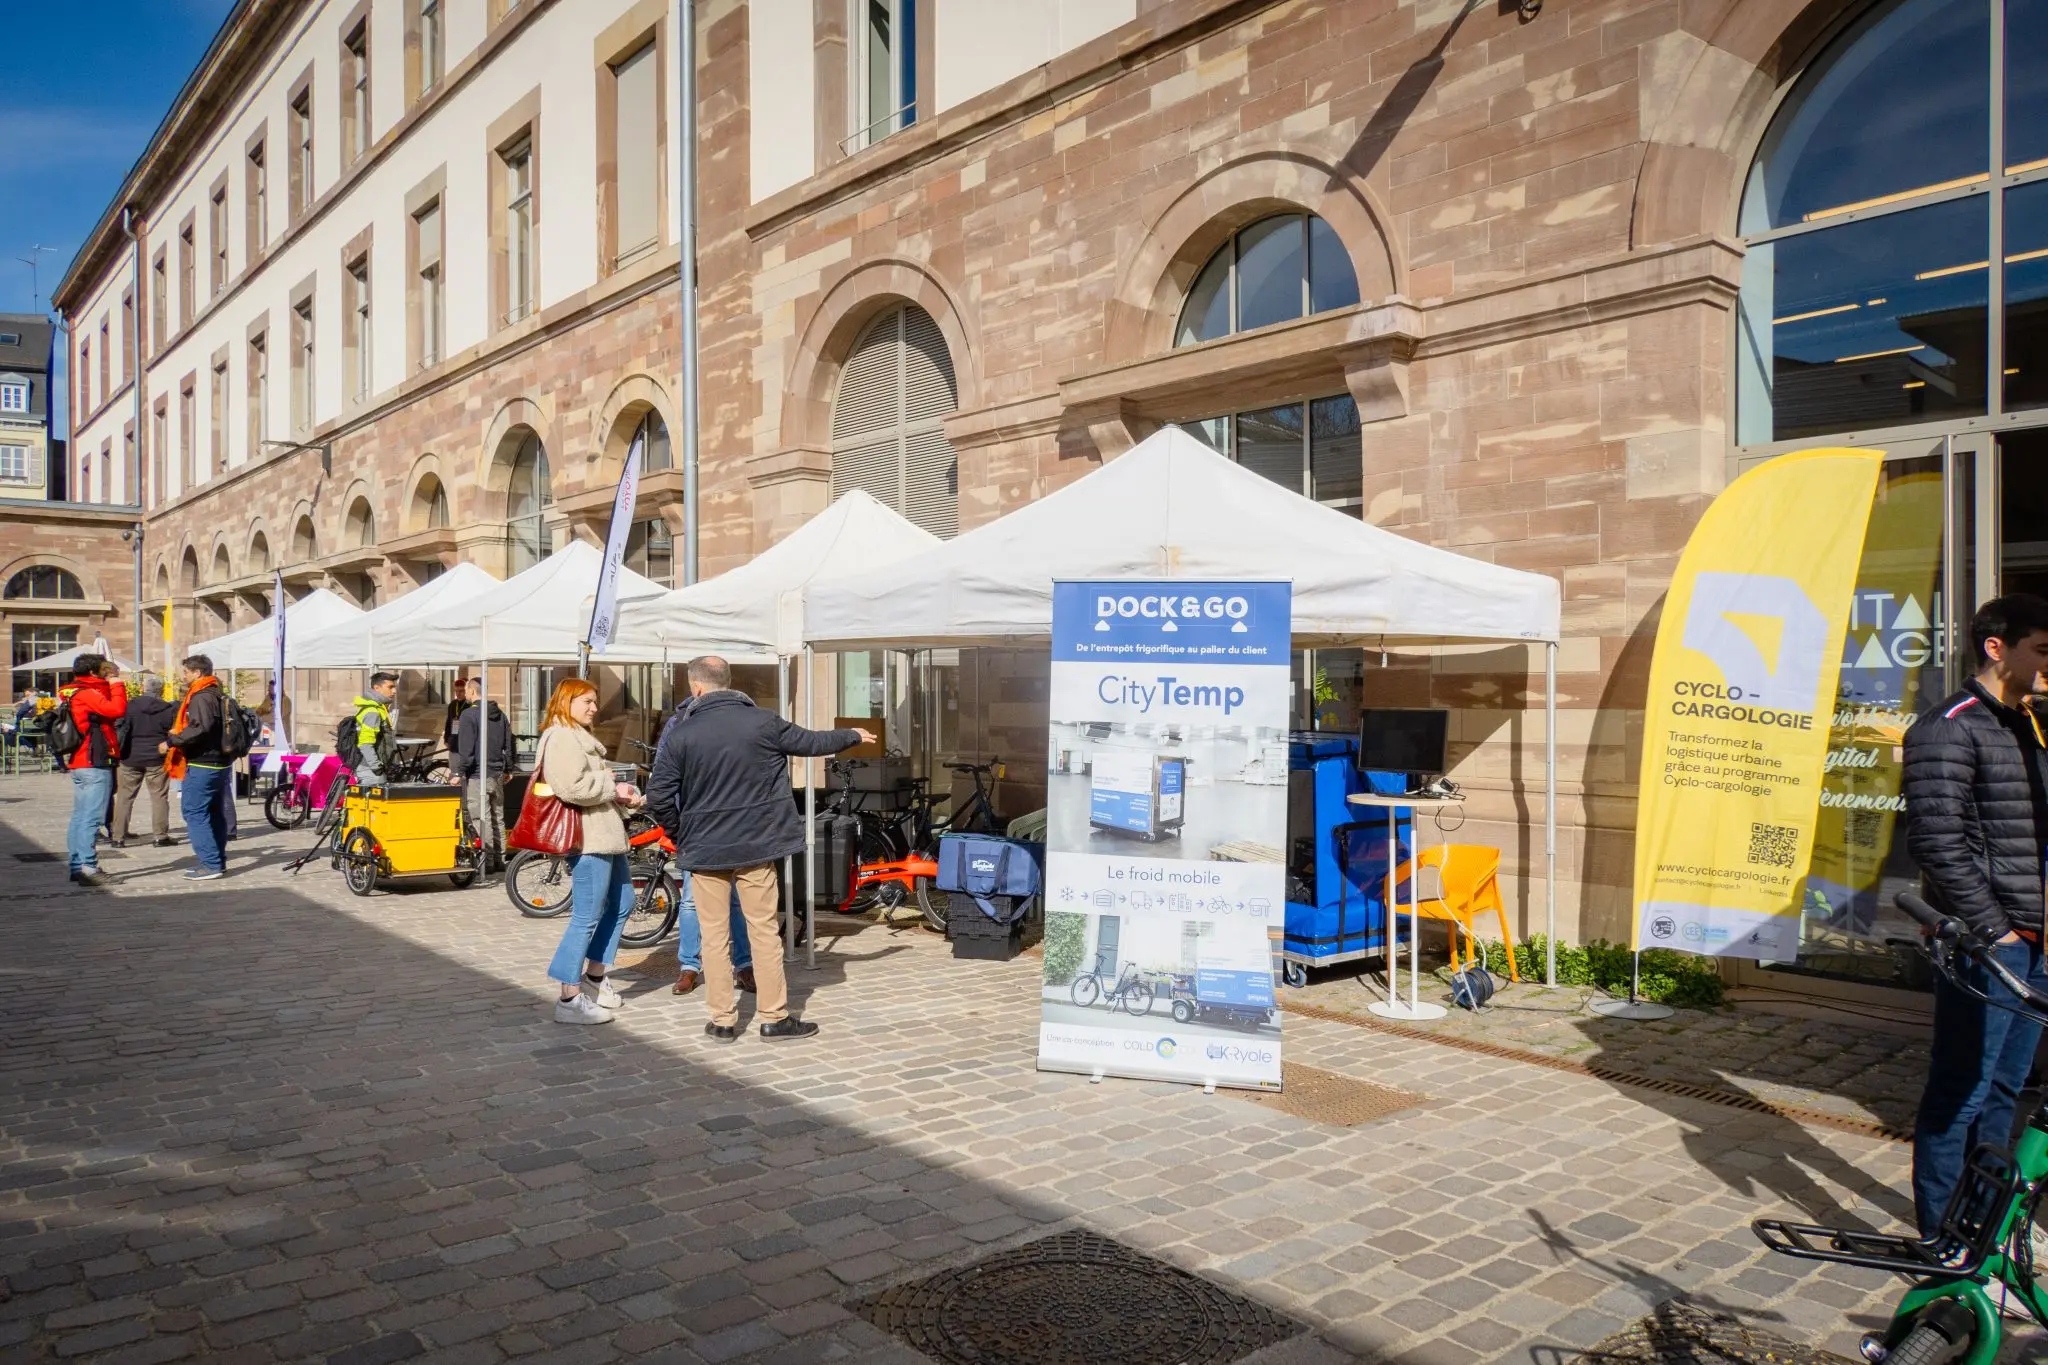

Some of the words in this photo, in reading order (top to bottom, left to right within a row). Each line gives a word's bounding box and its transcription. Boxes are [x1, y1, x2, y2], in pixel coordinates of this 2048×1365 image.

[1097, 596, 1249, 619] DOCK&GO
[1076, 643, 1089, 652] De
[1090, 643, 1134, 655] l'entrepôt
[1135, 643, 1185, 656] frigorifique
[1187, 646, 1198, 654] au
[1200, 645, 1225, 656] palier
[1228, 645, 1240, 654] du
[1242, 645, 1268, 655] client
[1098, 675, 1245, 715] CityTemp
[1674, 680, 1743, 701] CYCLO
[1672, 700, 1814, 731] CARGOLOGIE
[1668, 731, 1748, 748] Transformez
[1751, 738, 1763, 751] la
[1666, 746, 1729, 762] logistique
[1732, 752, 1783, 768] urbaine
[1664, 761, 1701, 774] grâce
[1703, 765, 1720, 775] au
[1722, 768, 1801, 786] programme
[1664, 774, 1772, 797] Cyclo-cargologie
[1108, 865, 1124, 880] Le
[1129, 866, 1164, 882] froid
[1168, 869, 1221, 885] mobile
[1219, 1045, 1272, 1063] K-Ryole
